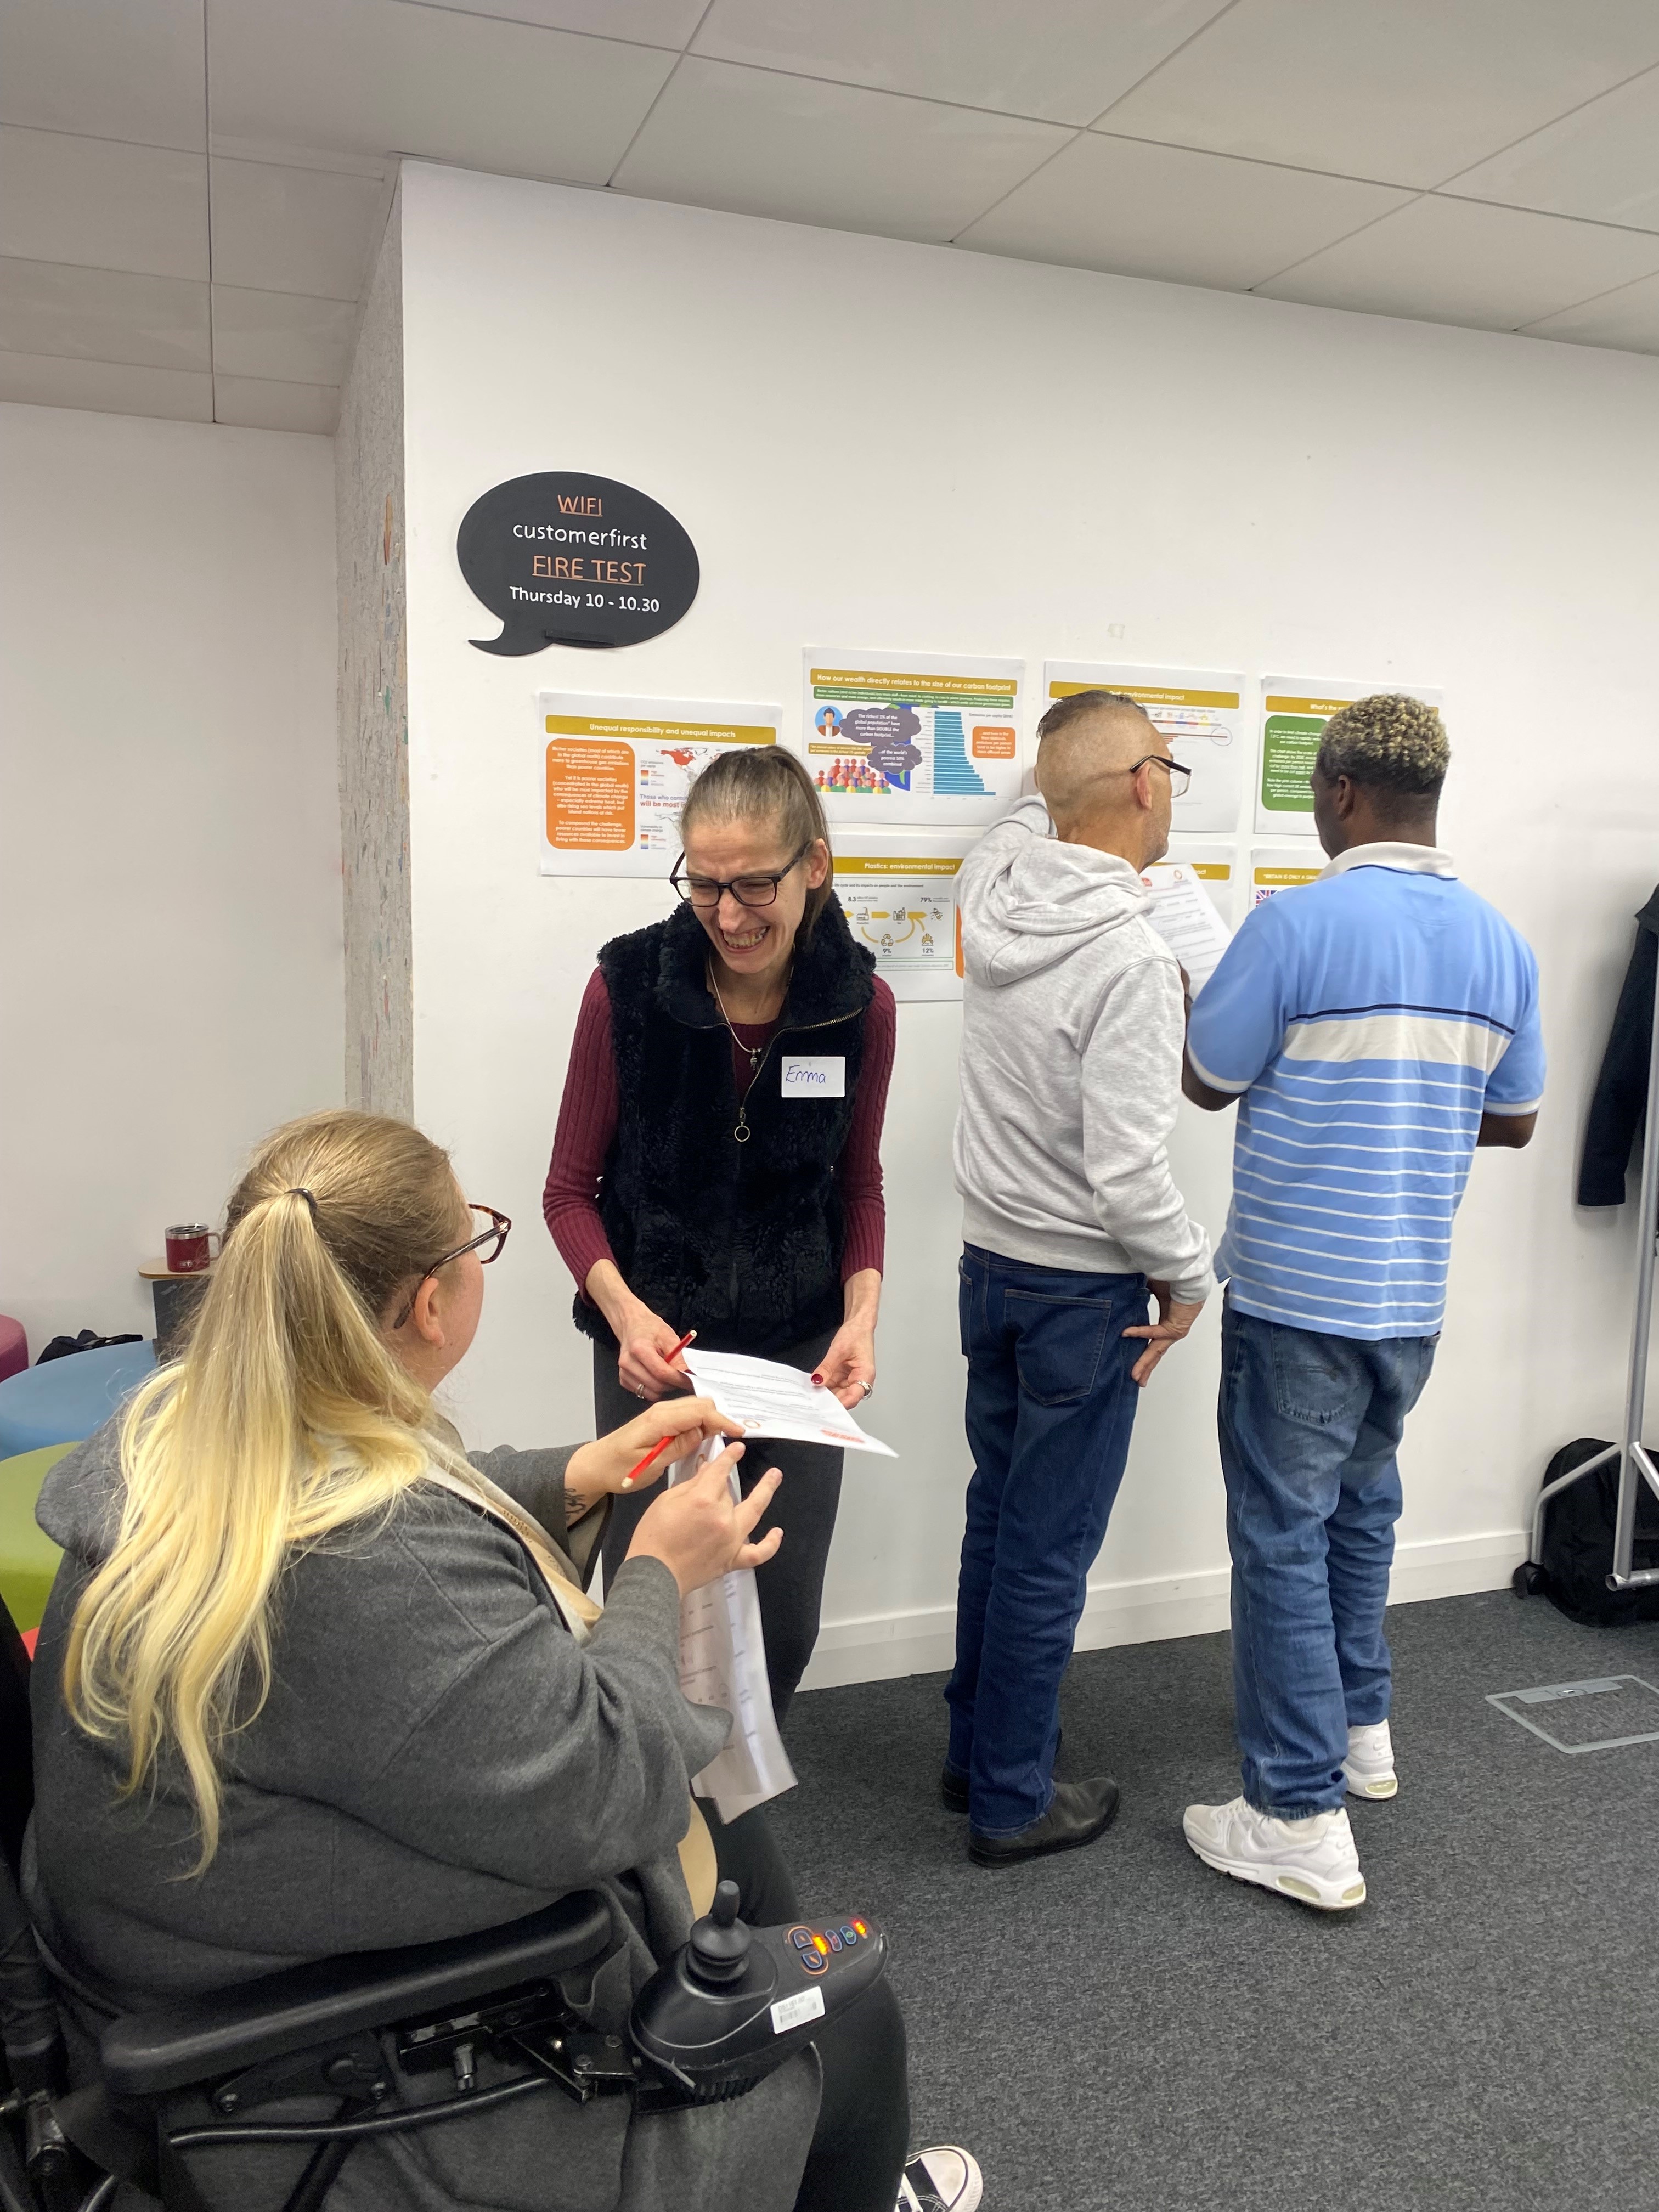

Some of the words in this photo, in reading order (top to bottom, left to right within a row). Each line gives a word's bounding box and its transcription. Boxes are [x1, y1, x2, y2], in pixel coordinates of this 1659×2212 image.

[558, 495, 602, 516] WIFI
[513, 524, 647, 550] customerfirst
[533, 555, 584, 578] FIRE
[591, 560, 646, 584] TEST
[510, 586, 580, 608] Thursday
[586, 593, 603, 607] 10
[619, 596, 659, 612] 10.30
[867, 678, 889, 686] directly
[590, 724, 618, 732] Unequal
[620, 726, 664, 735] responsibility
[786, 1065, 826, 1084] Emma
